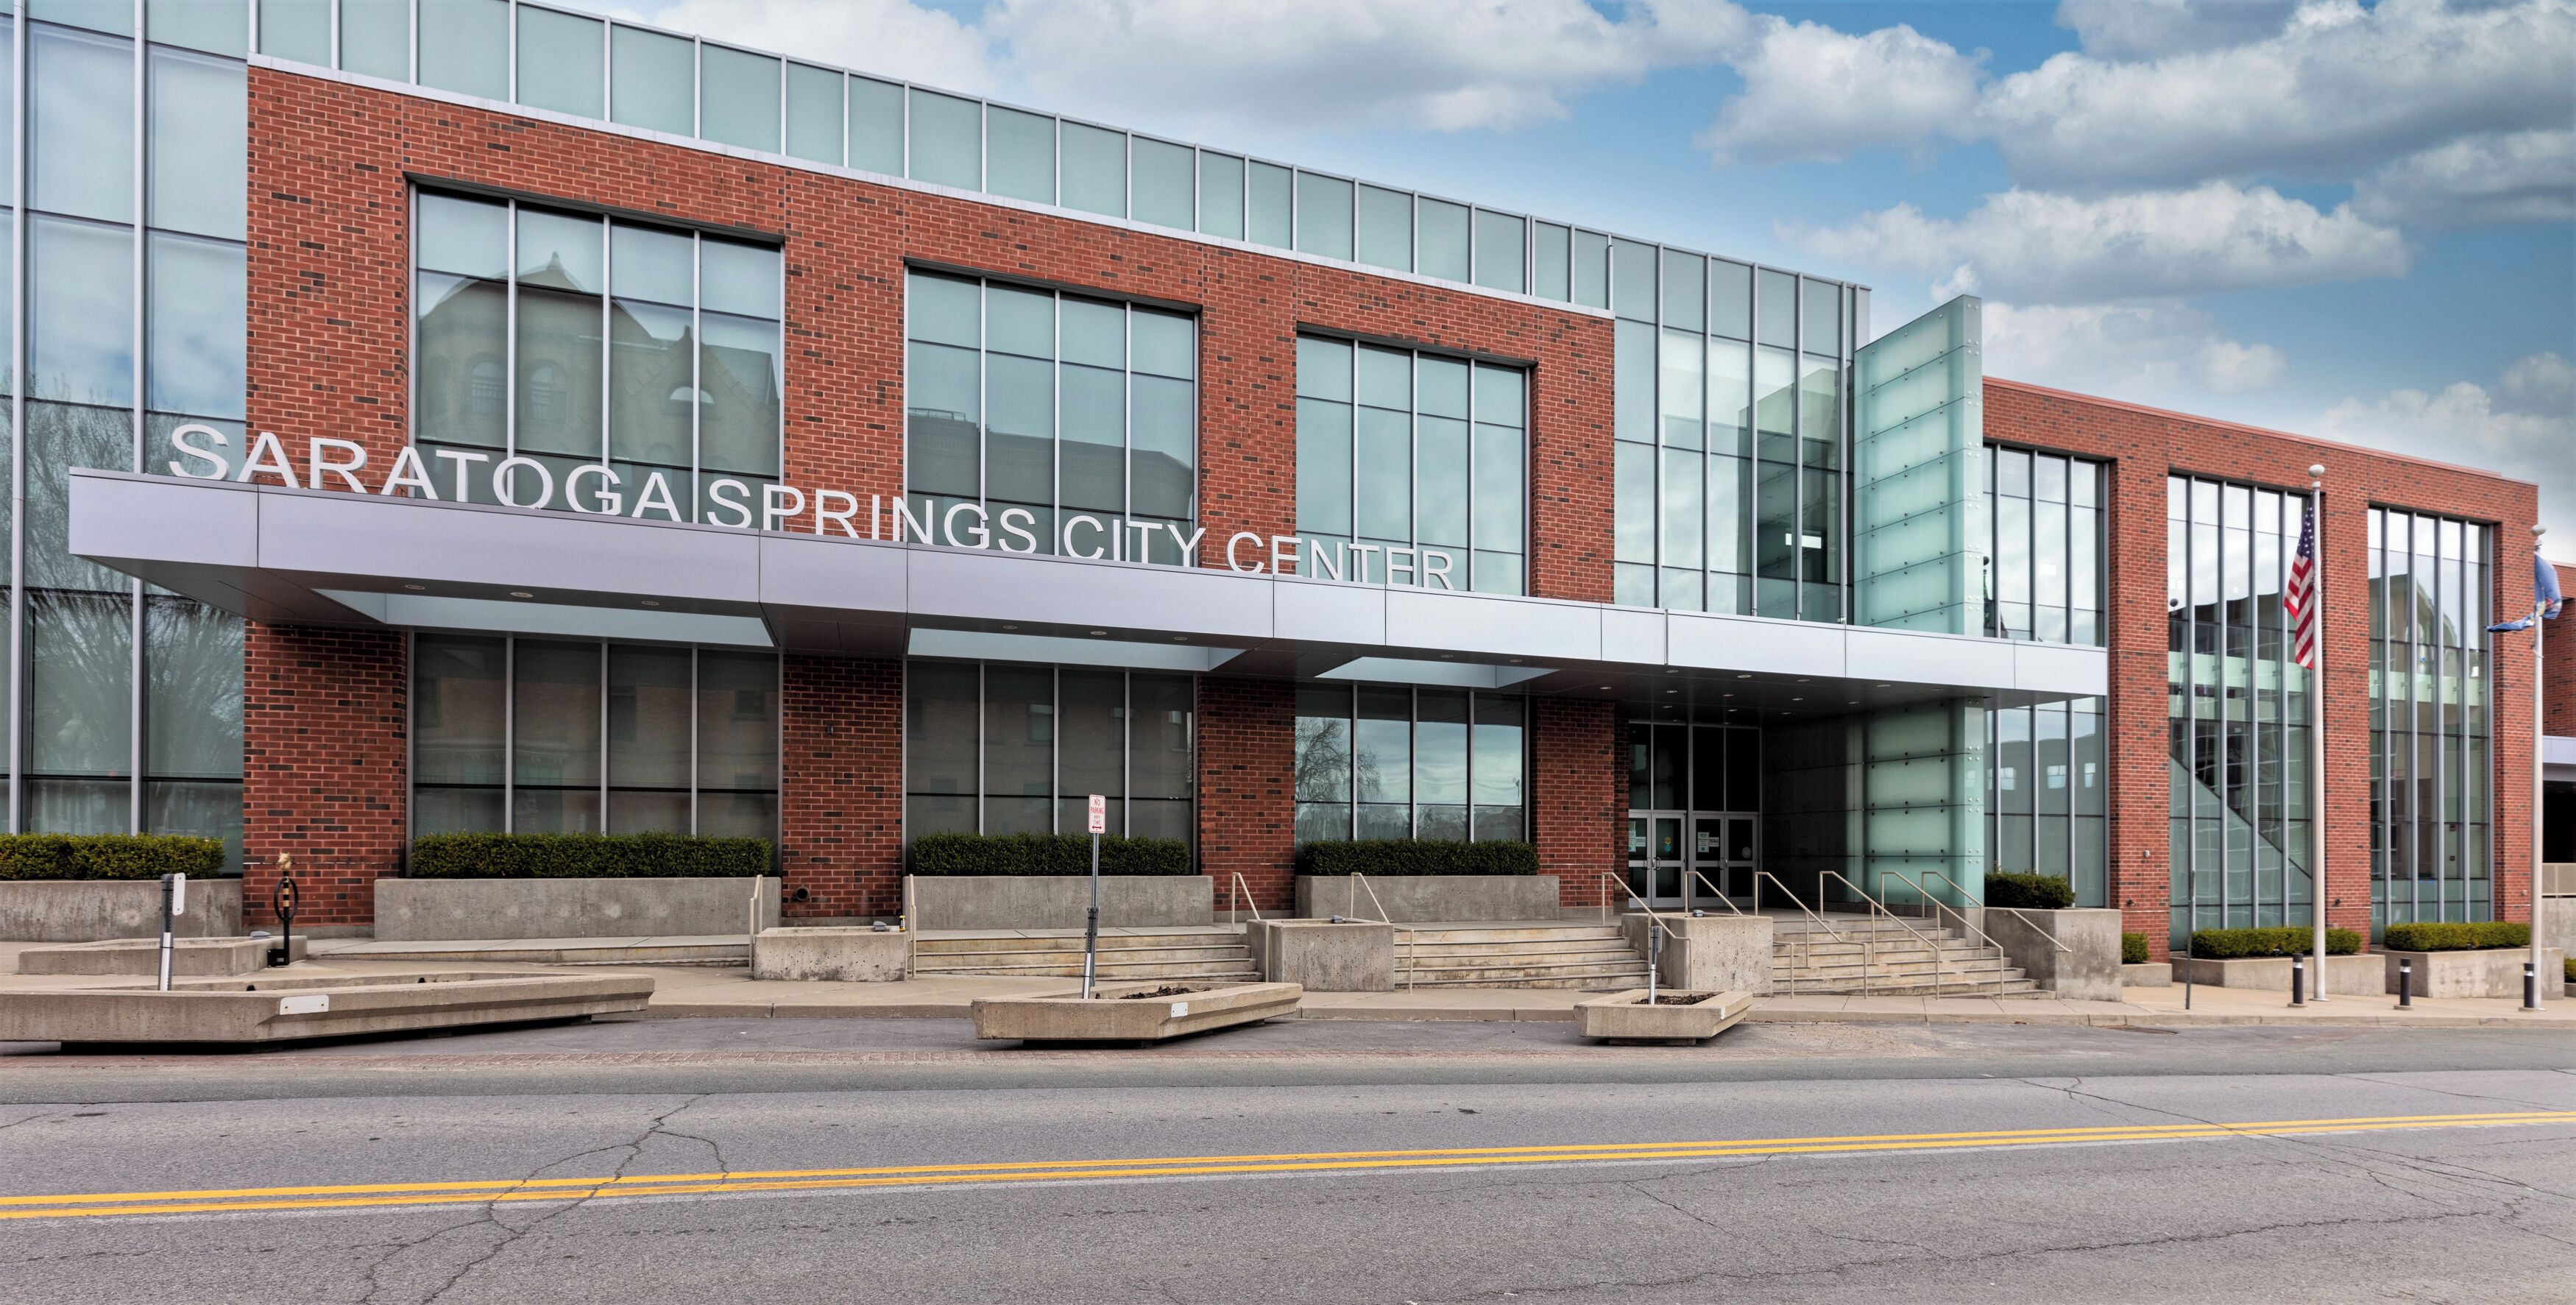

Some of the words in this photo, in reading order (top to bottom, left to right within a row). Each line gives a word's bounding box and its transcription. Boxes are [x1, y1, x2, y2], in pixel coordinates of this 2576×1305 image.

[169, 424, 682, 523] SARATOGA
[707, 479, 1037, 554] SPRINGS
[1064, 515, 1206, 567] CITY
[1227, 531, 1455, 590] CENTER
